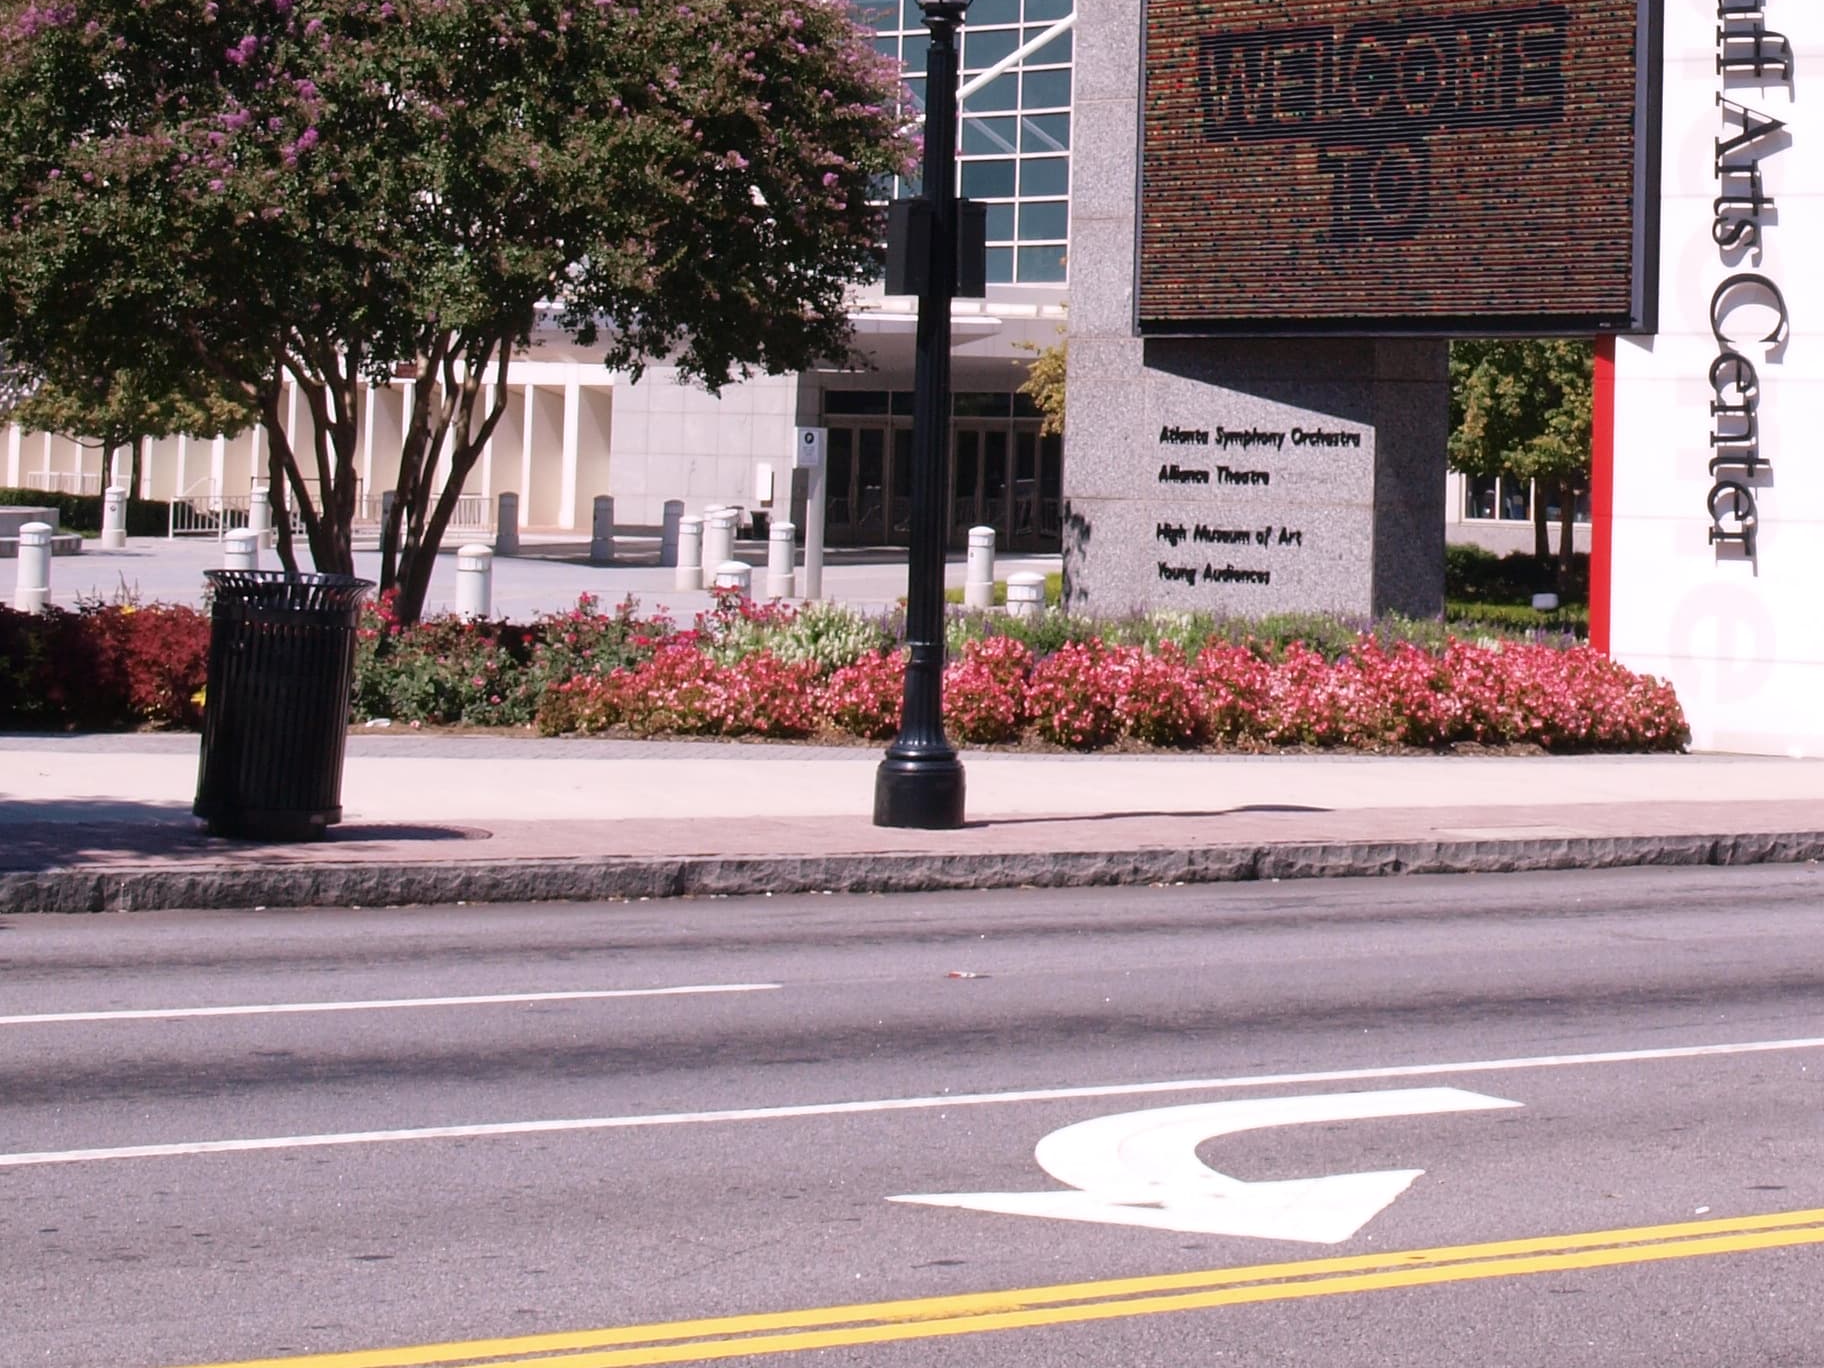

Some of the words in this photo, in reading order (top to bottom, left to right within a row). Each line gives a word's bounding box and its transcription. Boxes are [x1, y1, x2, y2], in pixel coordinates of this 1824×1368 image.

[1206, 23, 1557, 124] WELCOME
[1324, 142, 1422, 225] TO
[1711, 90, 1788, 247] Arts
[1159, 425, 1209, 445] Atlanta
[1215, 426, 1285, 451] Symphony
[1291, 427, 1360, 447] Orchestra
[1706, 272, 1785, 557] Center
[1158, 464, 1209, 483] Alliance
[1216, 465, 1270, 485] Theatre
[1156, 522, 1187, 546] High
[1194, 524, 1250, 544] Museum
[1255, 526, 1272, 549] of
[1278, 526, 1302, 546] Art
[1157, 561, 1197, 586] Young
[1203, 563, 1270, 585] Audiences
